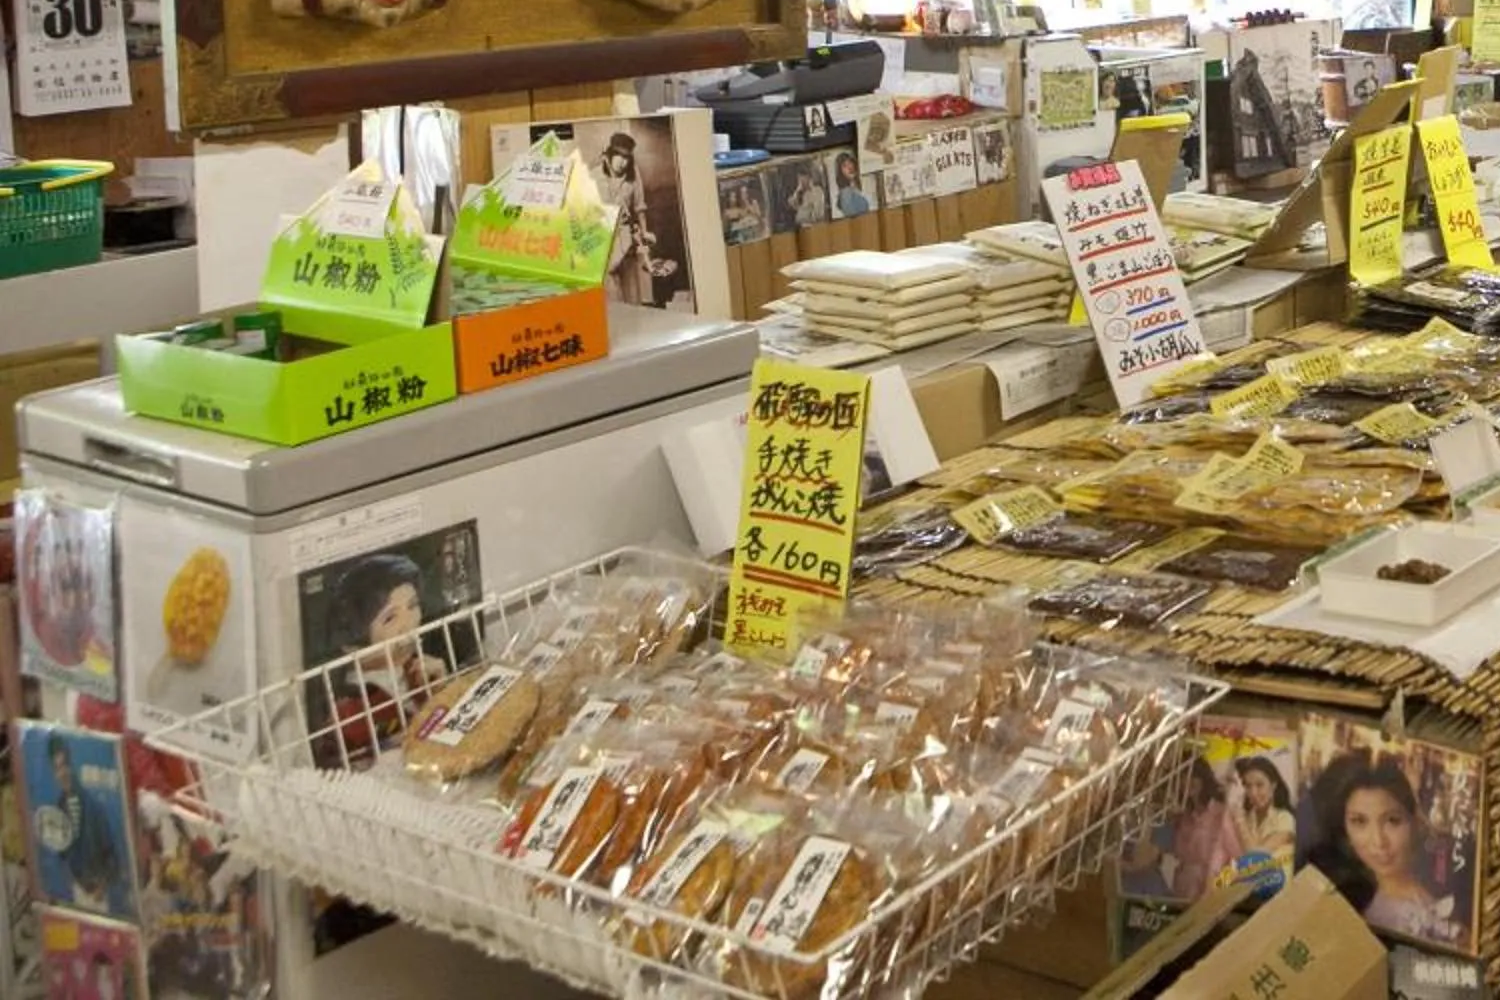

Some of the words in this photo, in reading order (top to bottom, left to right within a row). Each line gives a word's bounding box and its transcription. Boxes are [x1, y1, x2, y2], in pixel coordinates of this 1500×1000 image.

[292, 252, 382, 295] 山椒粉
[489, 334, 586, 379] 山椒七味
[324, 375, 429, 427] 山椒粉
[756, 434, 834, 479] 手焼き
[750, 481, 846, 526] がんこ焼
